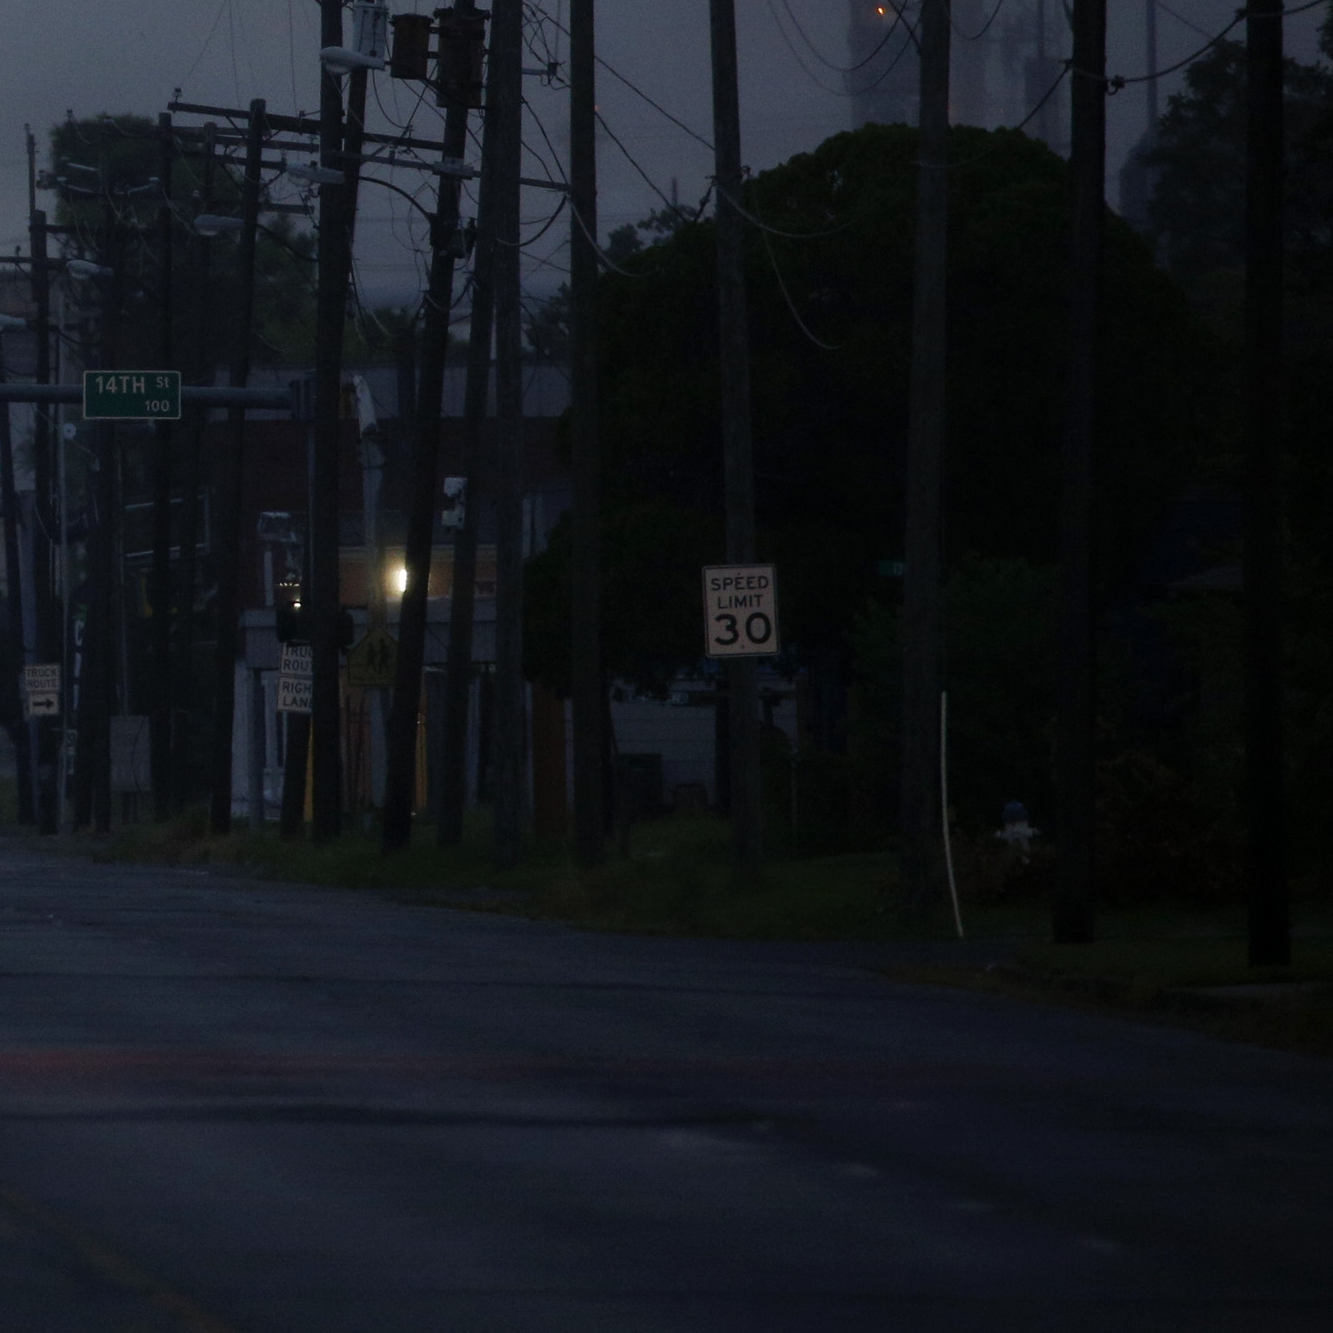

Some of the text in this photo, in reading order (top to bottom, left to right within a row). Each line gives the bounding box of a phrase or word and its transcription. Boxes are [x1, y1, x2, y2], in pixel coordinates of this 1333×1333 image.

[95, 375, 171, 394] 14TH St
[144, 400, 171, 412] 100
[710, 575, 770, 591] SPEED
[717, 594, 764, 609] LIMIT
[714, 611, 772, 645] 30
[285, 645, 313, 658] TRU
[283, 658, 313, 671] ROU
[26, 667, 58, 677] TRUCK
[26, 679, 57, 688] ROUTE
[282, 681, 313, 694] RIGH
